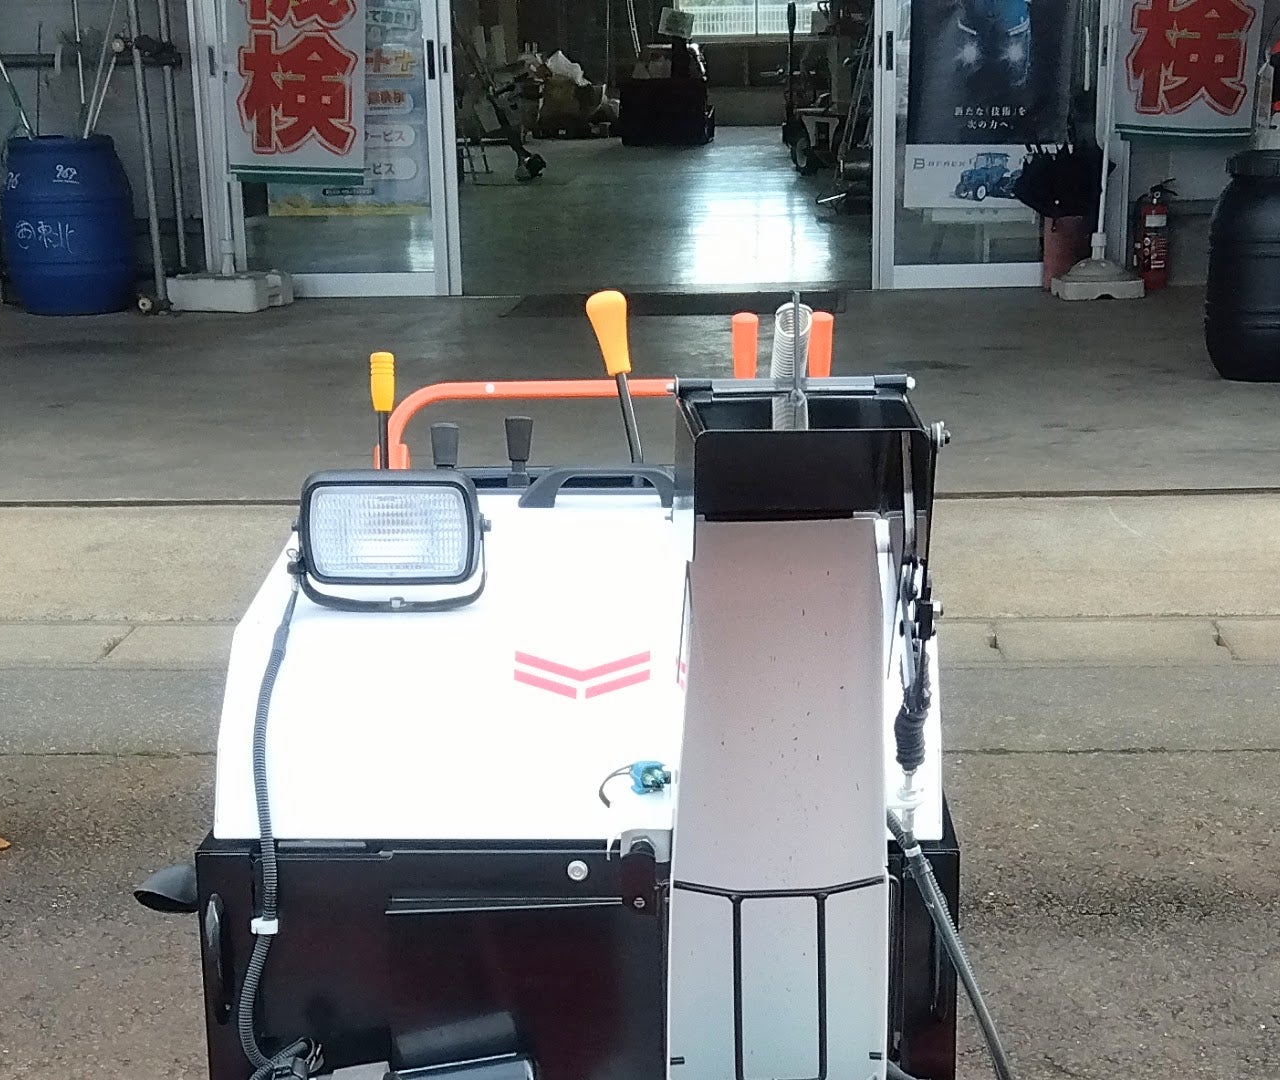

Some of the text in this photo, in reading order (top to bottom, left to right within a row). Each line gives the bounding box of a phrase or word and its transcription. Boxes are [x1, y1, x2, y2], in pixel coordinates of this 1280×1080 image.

[237, 0, 357, 157] 検
[1125, 0, 1256, 117] 検
[365, 129, 406, 143] ービス
